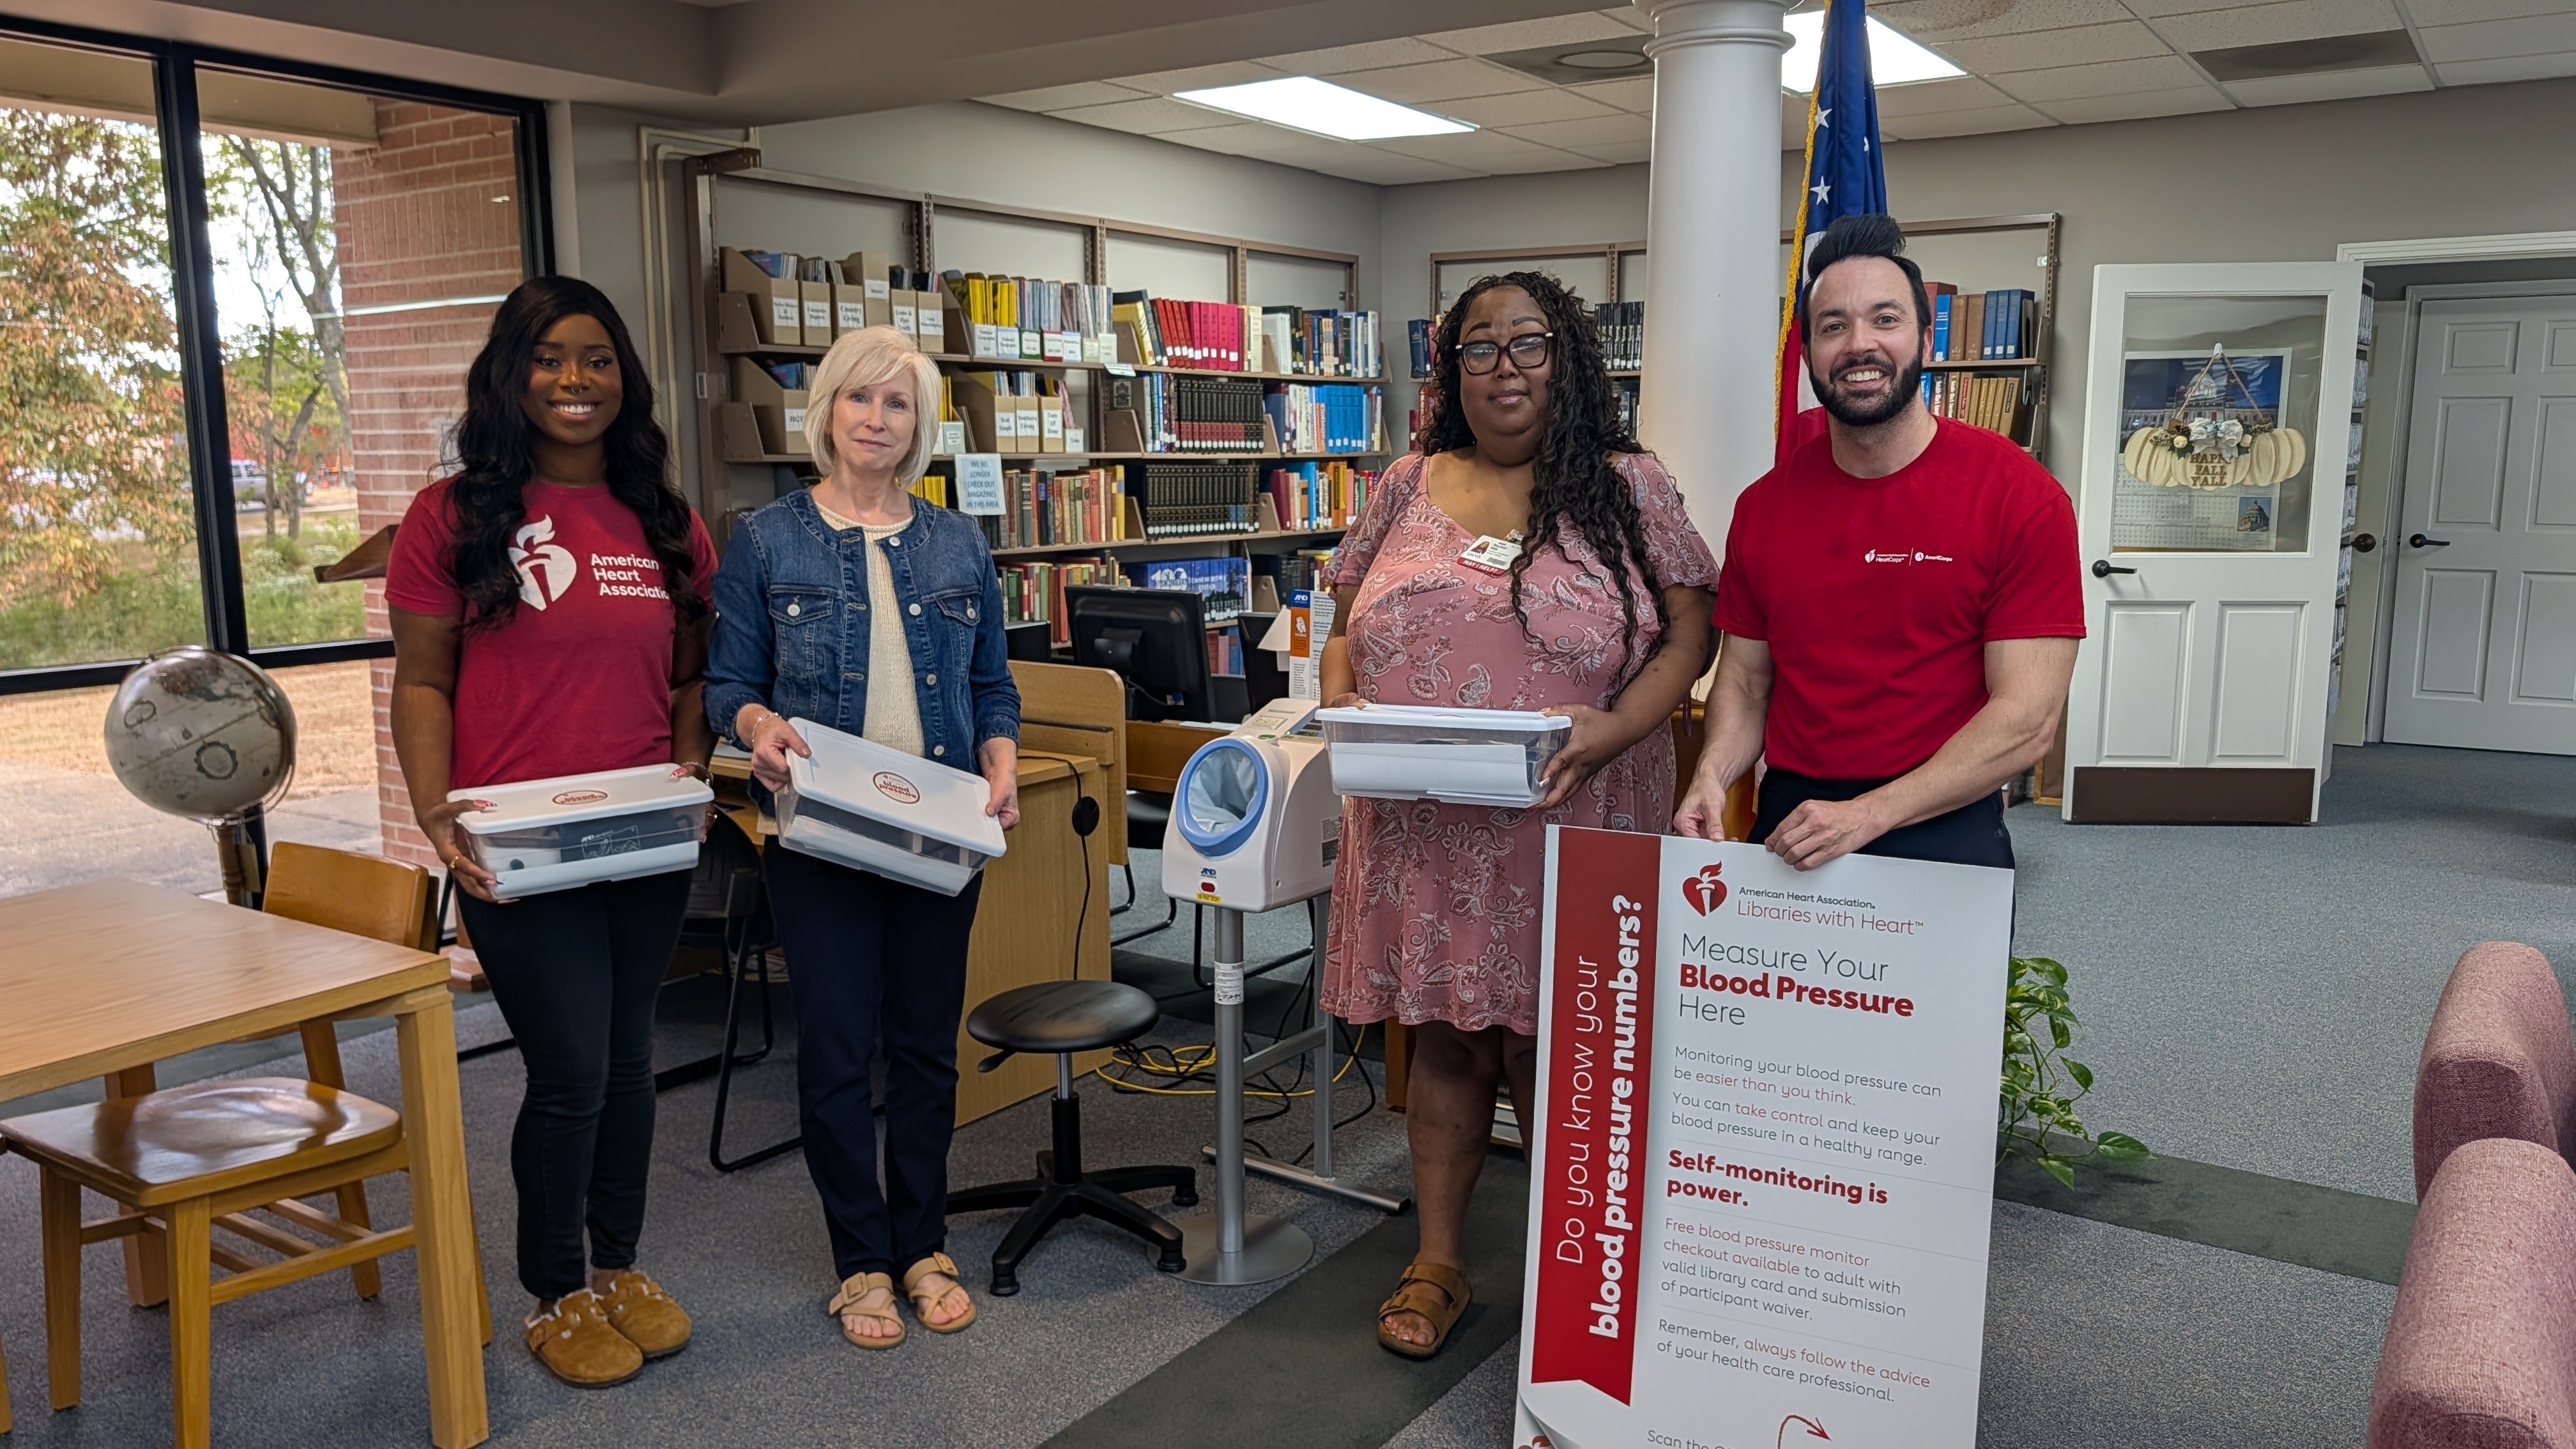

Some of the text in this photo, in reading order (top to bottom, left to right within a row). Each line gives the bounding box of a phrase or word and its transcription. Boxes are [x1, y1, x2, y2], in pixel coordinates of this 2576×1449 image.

[591, 553, 659, 571] American
[593, 567, 641, 582] Heart
[1478, 564, 1498, 573] HELP?
[599, 583, 670, 600] Associatio
[1737, 899, 1811, 923] Libraries
[1814, 909, 1855, 928] with
[1738, 885, 1784, 900] American
[1786, 891, 1814, 903] Heart
[1682, 932, 1889, 982] Measure Your
[1678, 992, 1745, 1025] Here
[1679, 962, 1914, 1017] Blood Pressure
[1673, 1064, 1855, 1106] be easier than you think.
[1675, 1045, 1941, 1098] Monitoring your blood pressure can
[1556, 954, 1602, 1264] Do you know your
[1588, 894, 1642, 1339] blood pressure numbers?
[1671, 1091, 1940, 1146] You can take control and keep your
[1671, 1110, 1926, 1166] blood pressure in a healthy range.
[1666, 1178, 1749, 1207] power.
[1667, 1149, 1888, 1204] Self-monitoring is
[1663, 1238, 1901, 1295] checkout available to adult with
[1665, 1216, 1870, 1267] Free blood pressure monitor
[1660, 1279, 1813, 1321] of participant waiver.
[1661, 1259, 1906, 1318] valid library card and submission
[1656, 1340, 1894, 1402] of your health care professional.
[1658, 1318, 1930, 1388] Remember, always follow the advice
[1647, 1429, 1682, 1448] Scan
